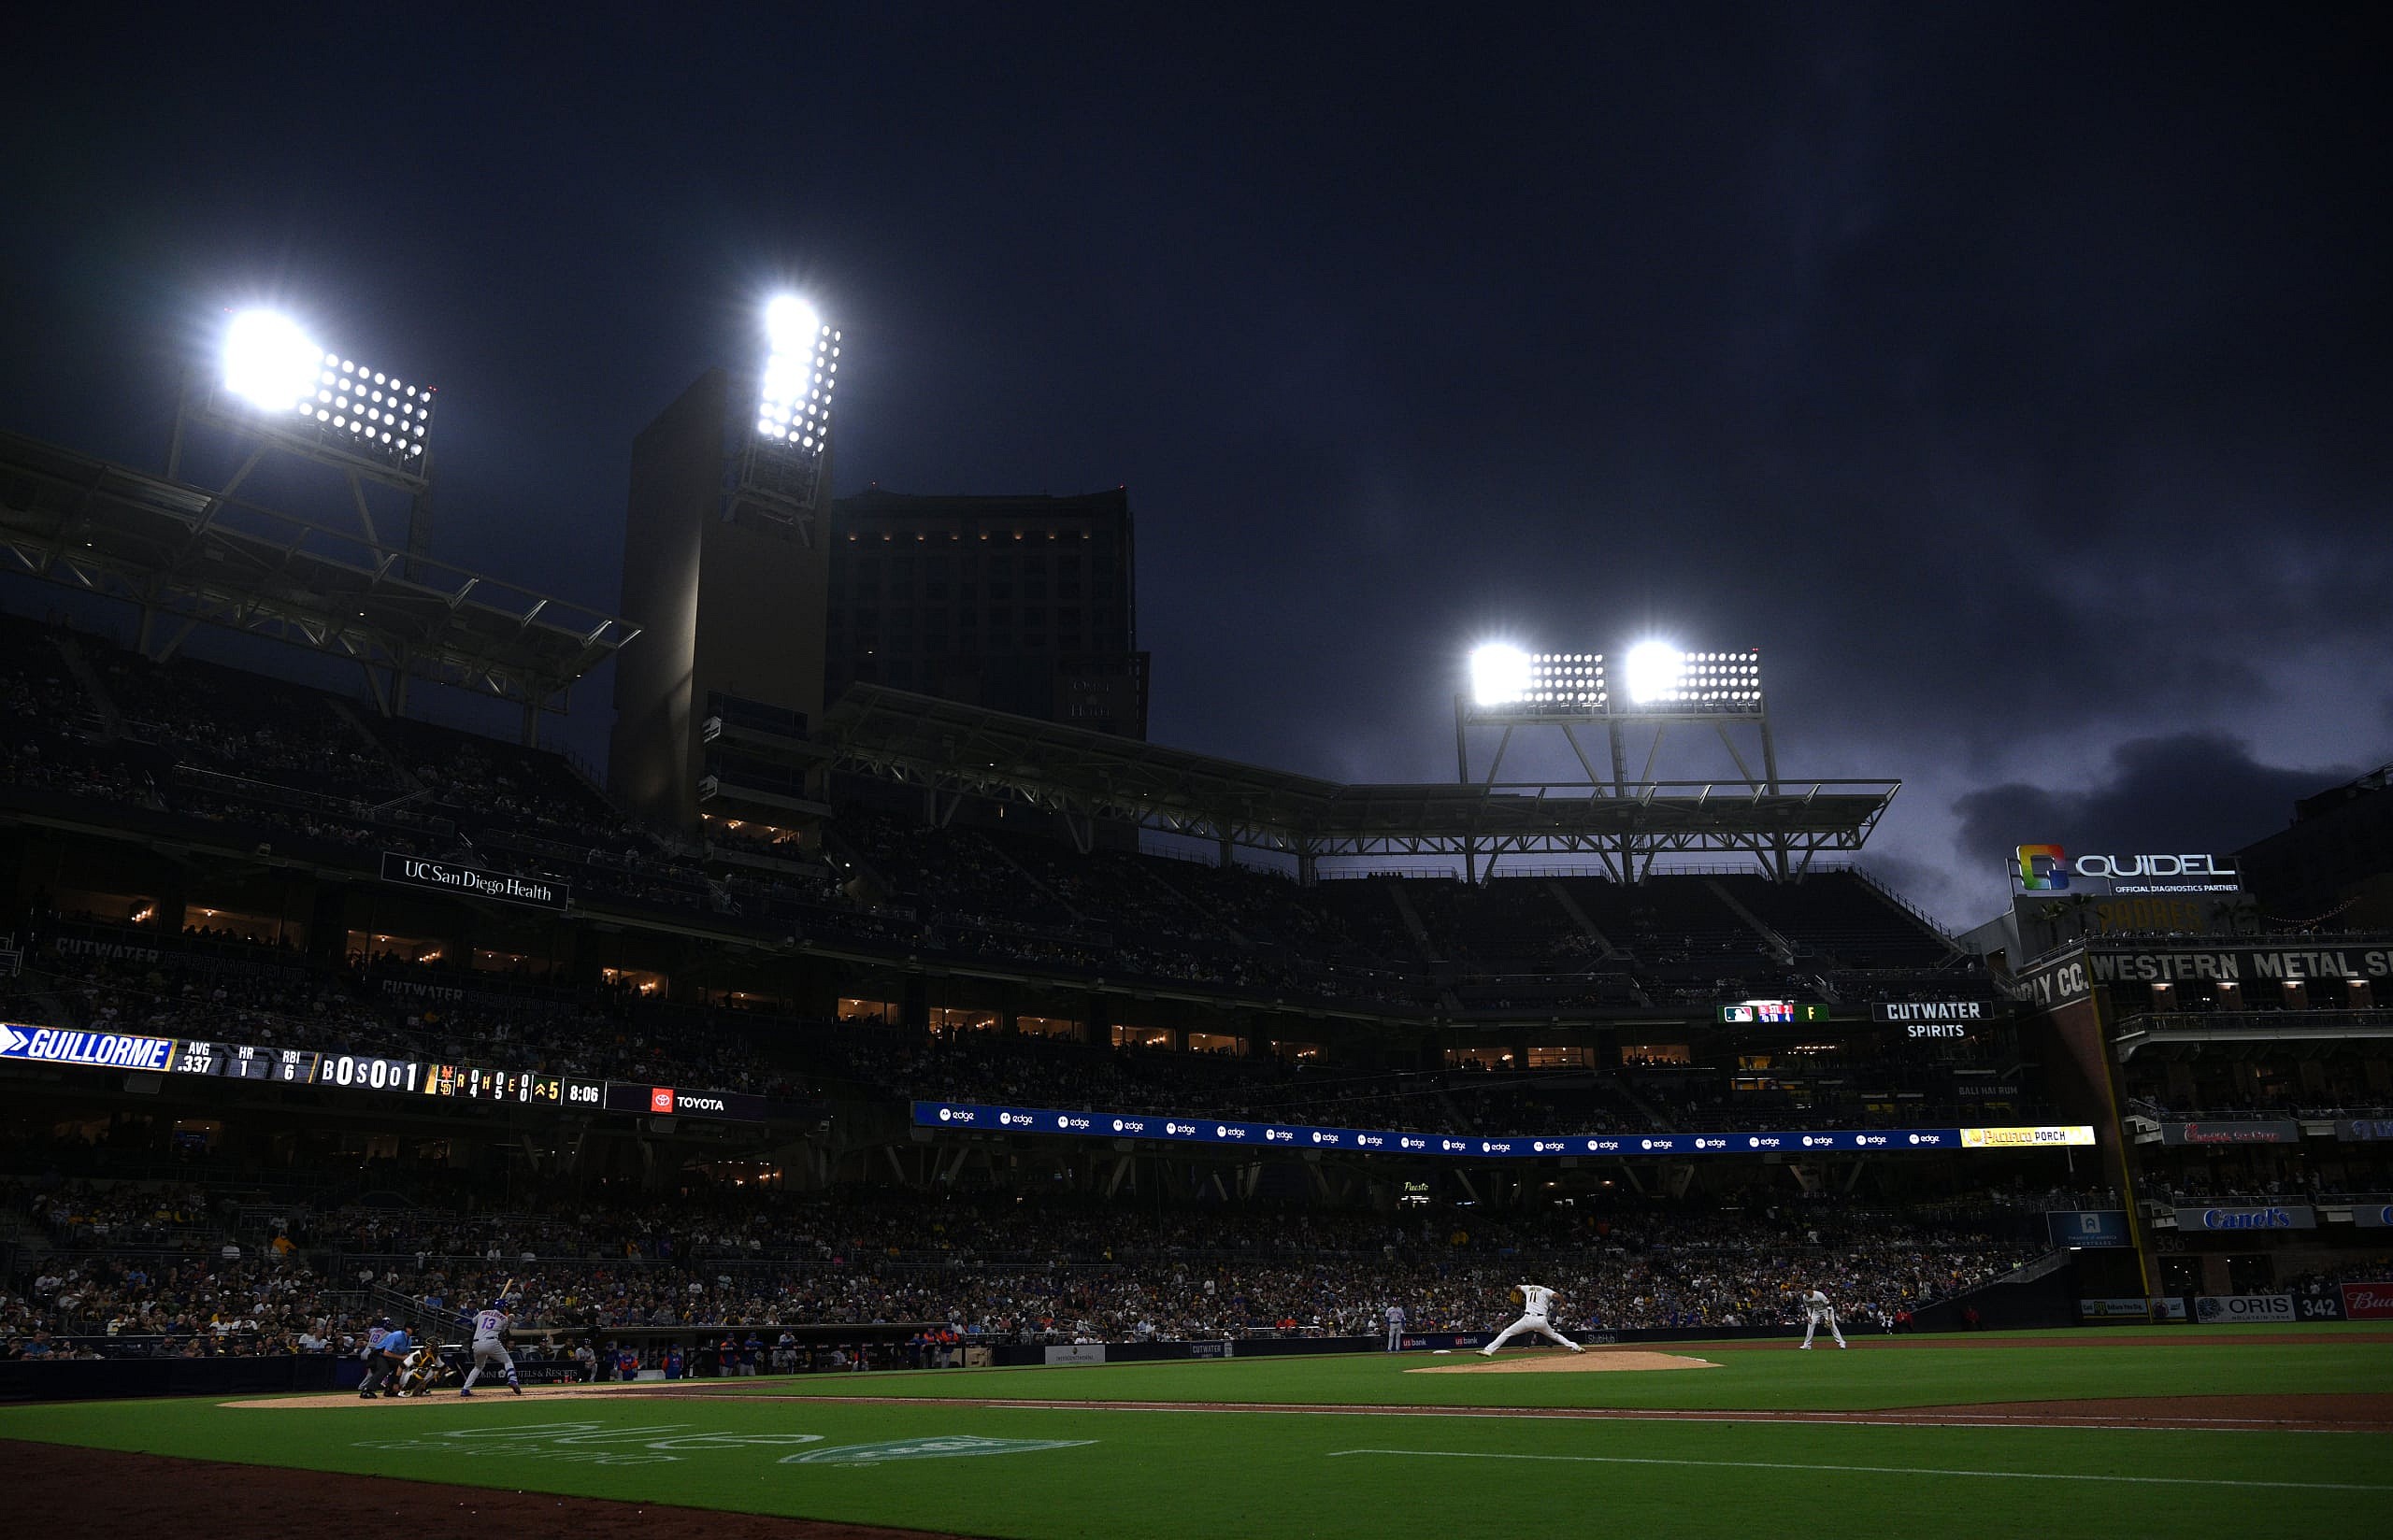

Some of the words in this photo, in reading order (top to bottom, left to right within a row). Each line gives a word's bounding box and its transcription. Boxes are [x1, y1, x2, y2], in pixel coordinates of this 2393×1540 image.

[2075, 853, 2235, 878] QUIDEL
[404, 860, 431, 880] UC
[431, 865, 460, 885] San
[464, 870, 504, 894] Diego
[507, 878, 552, 901] Health
[2115, 885, 2150, 893] OFFICIAL
[2151, 884, 2203, 892] DIAGNOSTICS
[2204, 883, 2240, 891] PARTNER
[2097, 899, 2203, 932] PADRES
[55, 936, 159, 963] CUTWATER
[2090, 953, 2240, 980] WESTERN
[2252, 951, 2358, 978] METAL
[2057, 962, 2089, 997] CO.
[381, 979, 464, 1002] CUTWATER
[1808, 1006, 1814, 1020] F
[1886, 1002, 1981, 1020] CUTWATER
[1908, 1024, 1964, 1037] SPIRITS
[28, 1029, 170, 1068] GUILLORME
[188, 1041, 210, 1057] AVG
[238, 1047, 253, 1059] HR
[283, 1050, 300, 1064] RBI
[178, 1056, 212, 1074] .337
[240, 1060, 248, 1077] 1
[284, 1064, 294, 1080] 6
[322, 1060, 334, 1081] B
[356, 1062, 367, 1084] S
[407, 1063, 417, 1091] 1
[457, 1074, 466, 1088] R
[471, 1069, 480, 1083] 0
[482, 1076, 491, 1091] H
[496, 1071, 505, 1086] 0
[509, 1078, 515, 1092] E
[521, 1074, 529, 1088] 0
[469, 1086, 479, 1098] 4
[494, 1087, 503, 1100] 5
[520, 1088, 528, 1102] 0
[548, 1081, 559, 1100] 5
[569, 1085, 599, 1103] 8:06
[677, 1096, 724, 1111] TOYOTA
[953, 1110, 975, 1122] edge
[1012, 1115, 1033, 1126] edge
[1070, 1118, 1090, 1130] edge
[1125, 1121, 1144, 1133] edge
[1178, 1125, 1196, 1136] edge
[1227, 1128, 1246, 1139] edge
[1277, 1131, 1294, 1142] edge
[2034, 1132, 2066, 1141] PORCH
[1323, 1134, 1340, 1144] edge
[1368, 1136, 1383, 1147] edge
[1410, 1139, 1426, 1149] edge
[1654, 1140, 1673, 1150] edge
[1707, 1138, 1727, 1149] edge
[1761, 1137, 1781, 1148] edge
[1814, 1136, 1834, 1147] edge
[1868, 1135, 1887, 1146] edge
[1921, 1134, 1941, 1145] edge
[1451, 1142, 1467, 1151] edge
[1492, 1142, 1512, 1153] edge
[1546, 1142, 1566, 1152] edge
[1599, 1140, 1619, 1151] edge
[1403, 1181, 1429, 1192] Puesto
[2203, 1207, 2290, 1228] Canel's
[2229, 1298, 2289, 1313] ORIS
[2302, 1299, 2337, 1316] 342
[481, 1318, 496, 1330] 13
[1588, 1332, 1615, 1344] StubHub
[1192, 1345, 1222, 1354] CUTWATER
[545, 1367, 578, 1377] RESORTS
